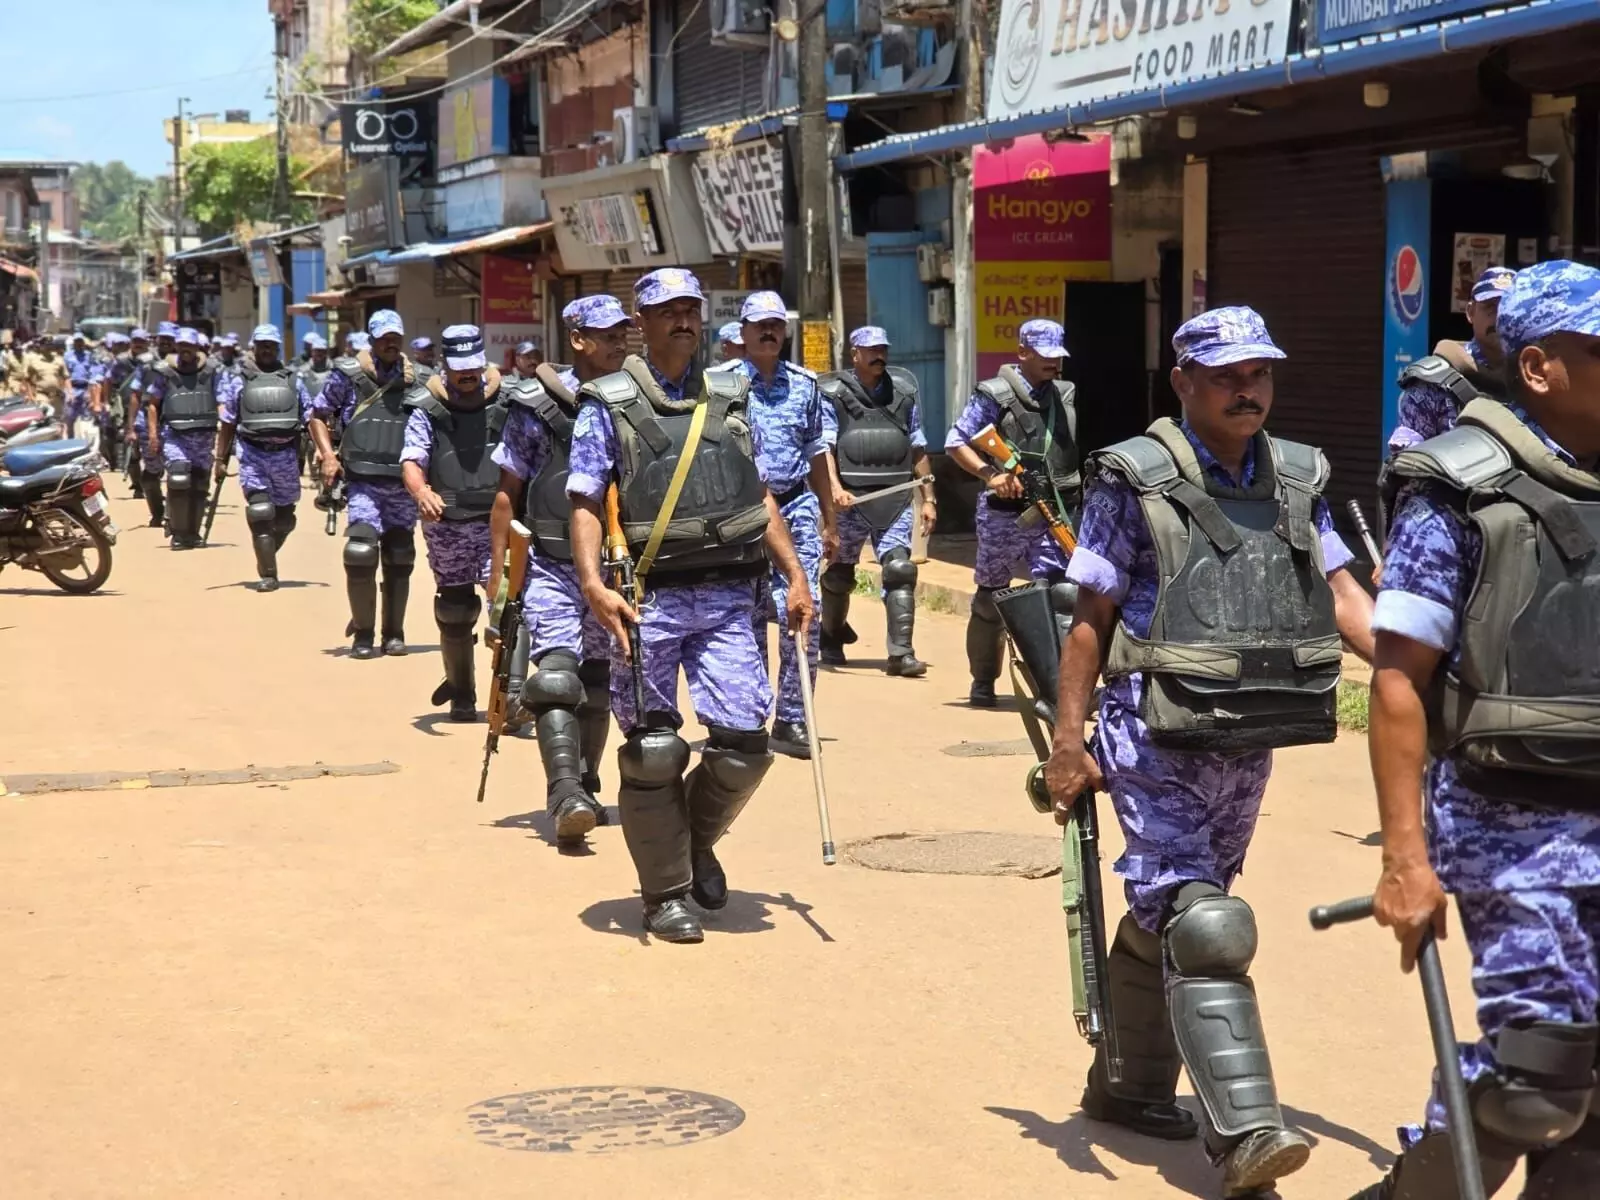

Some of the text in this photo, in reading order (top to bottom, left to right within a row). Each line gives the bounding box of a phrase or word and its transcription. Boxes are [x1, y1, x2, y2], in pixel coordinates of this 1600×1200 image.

[1132, 21, 1275, 84] FOOD MART
[714, 144, 775, 195] SHOES
[737, 190, 784, 244] GALLE
[988, 194, 1091, 224] Hangyo
[1012, 232, 1074, 245] ICE CREAM
[984, 295, 1060, 317] HASHI
[993, 323, 1020, 340] FO
